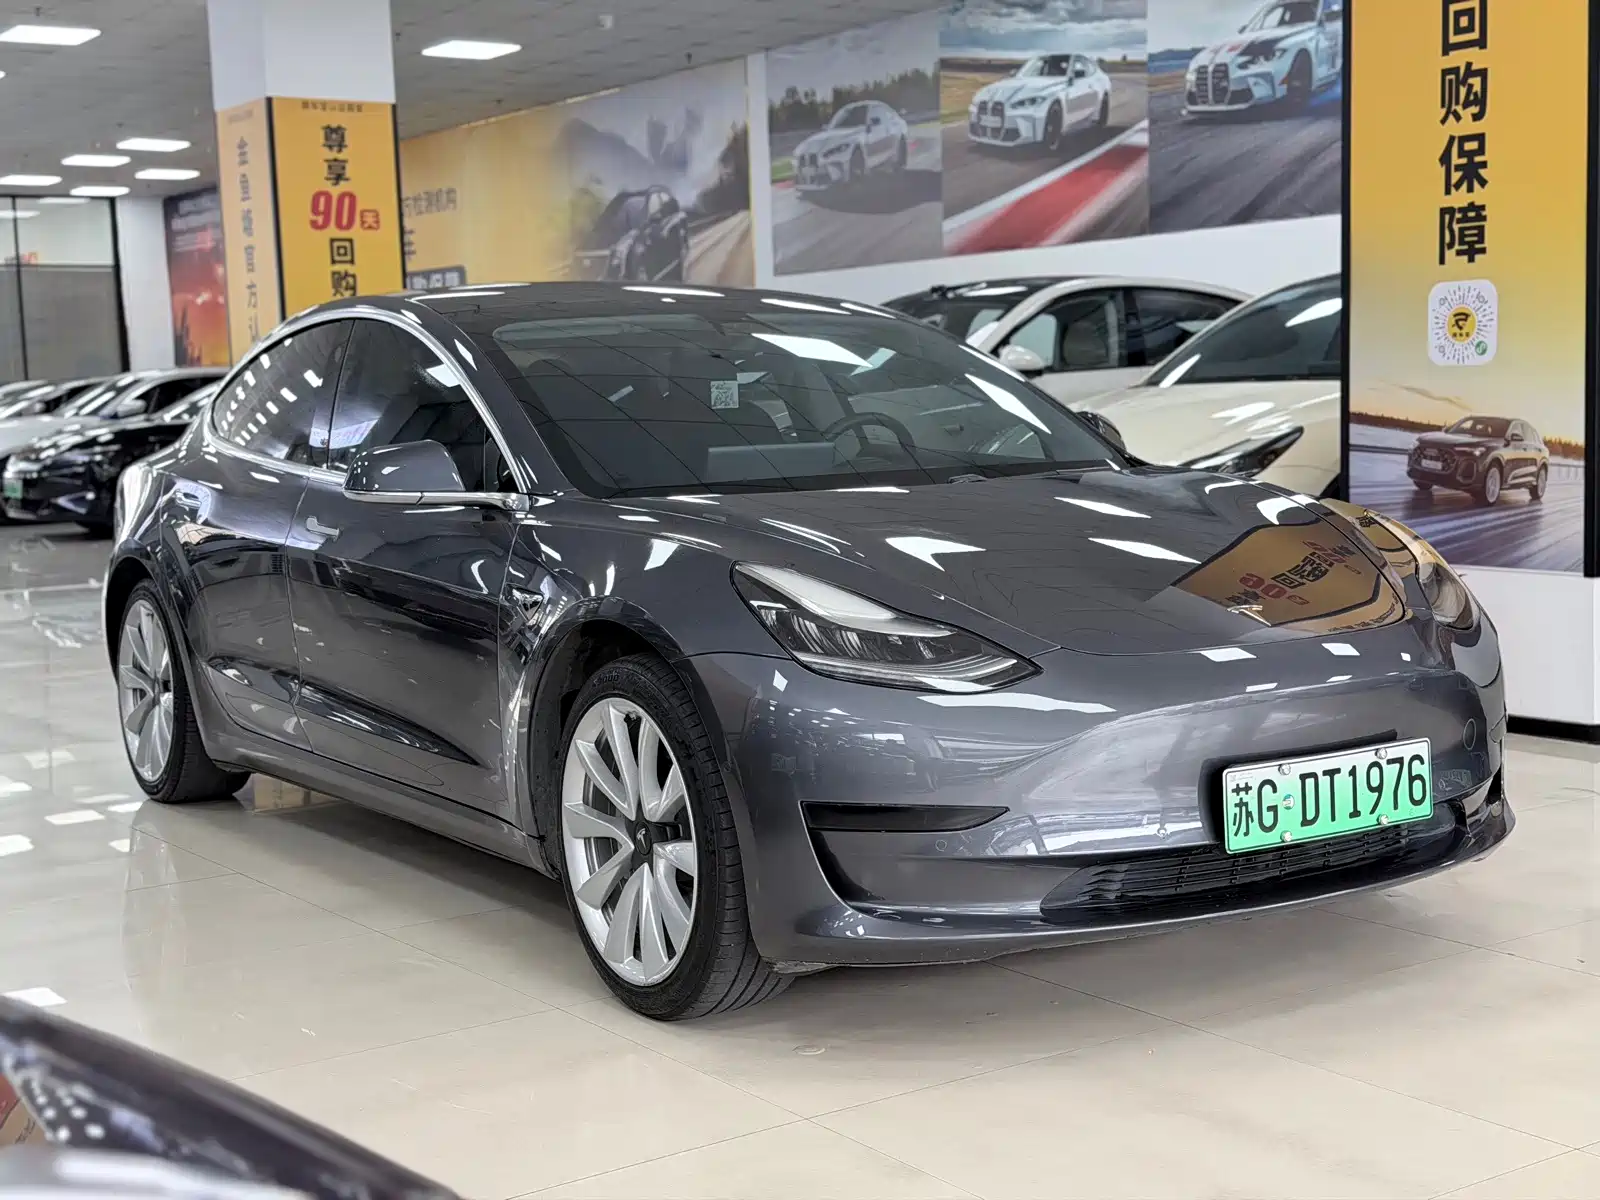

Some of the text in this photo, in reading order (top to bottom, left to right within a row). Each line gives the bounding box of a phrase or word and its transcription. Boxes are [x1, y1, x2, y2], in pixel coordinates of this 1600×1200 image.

[1438, 0, 1489, 266] 回购保障
[1231, 754, 1427, 838] 苏G DT1976
